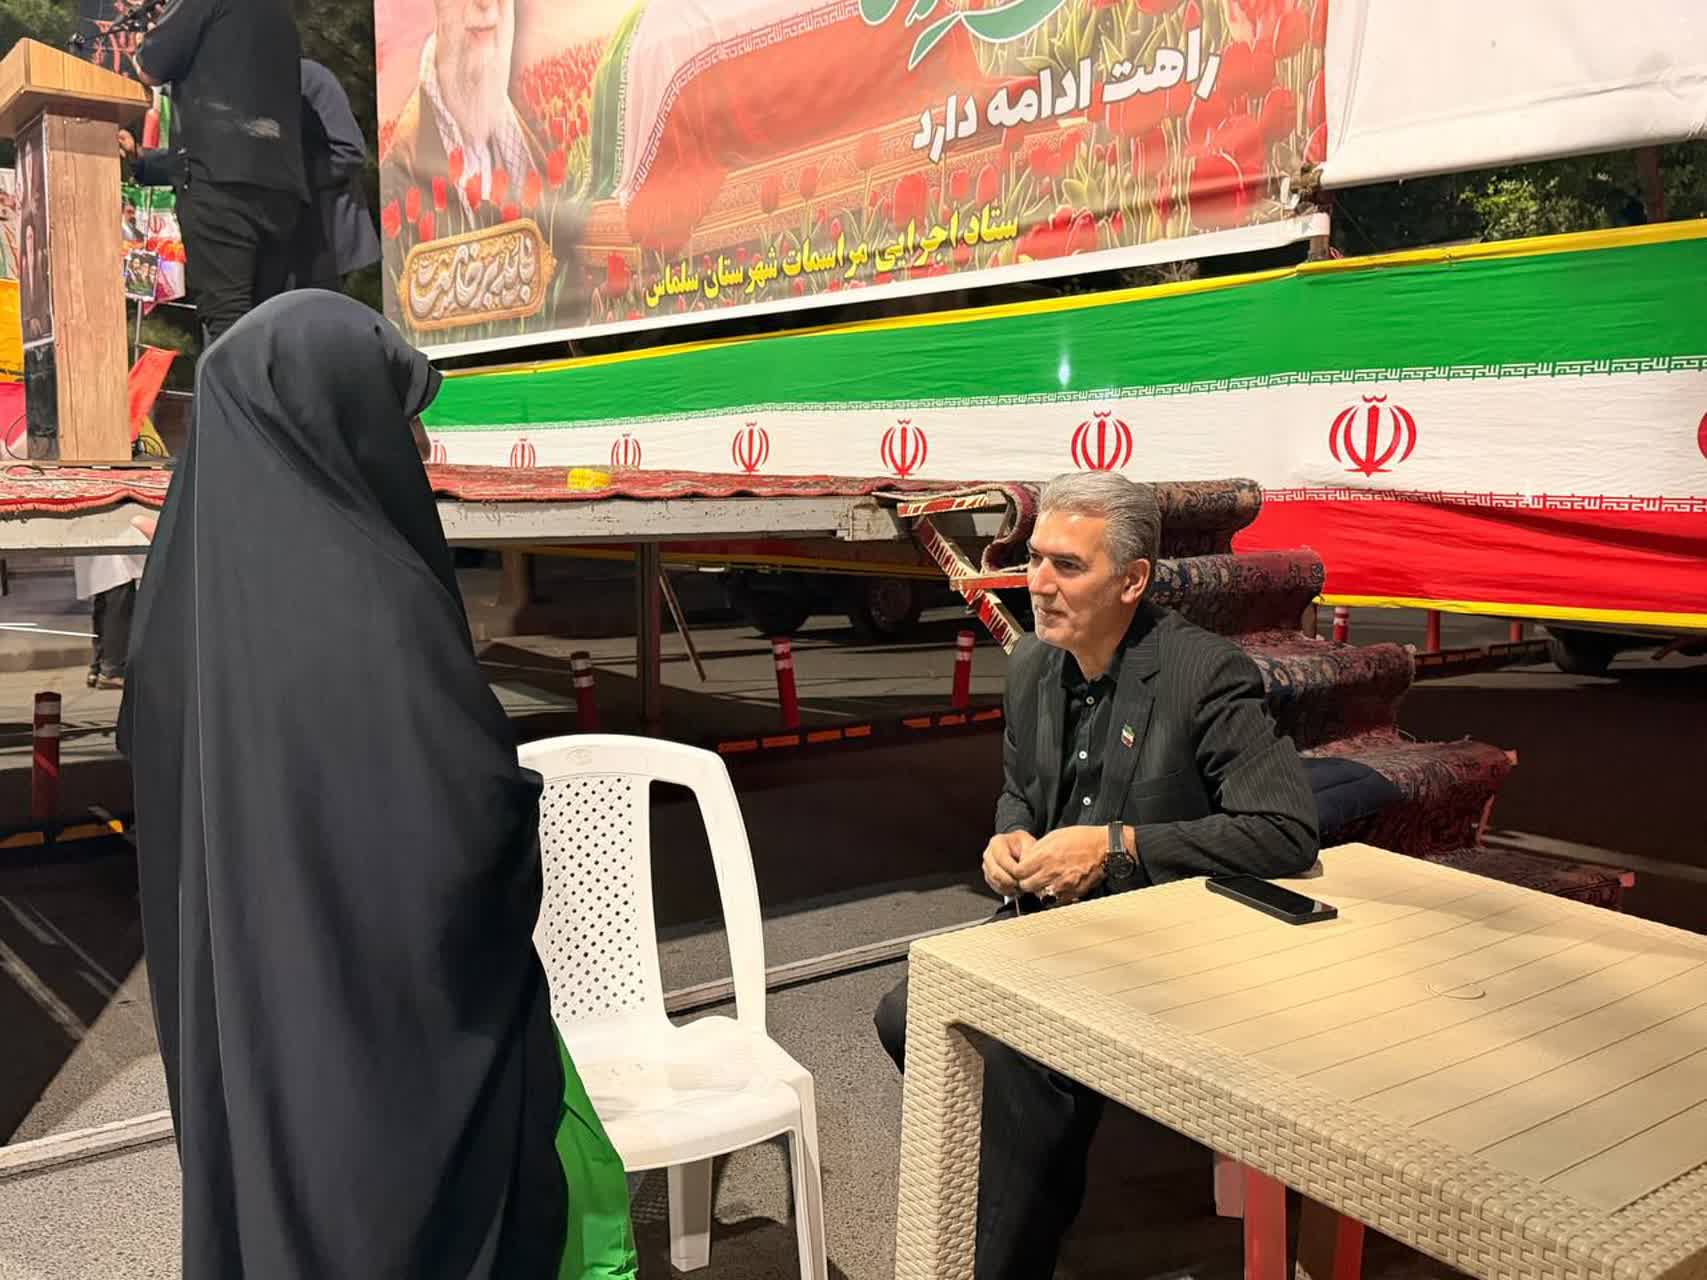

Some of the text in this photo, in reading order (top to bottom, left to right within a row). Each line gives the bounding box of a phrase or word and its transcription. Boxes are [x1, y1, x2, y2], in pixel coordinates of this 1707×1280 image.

[985, 57, 1092, 127] ادامه
[1102, 29, 1220, 100] راهت
[911, 95, 978, 163] دارد
[646, 203, 1019, 307] ستاد اجرایی مراسمات شهرستان سلماس
